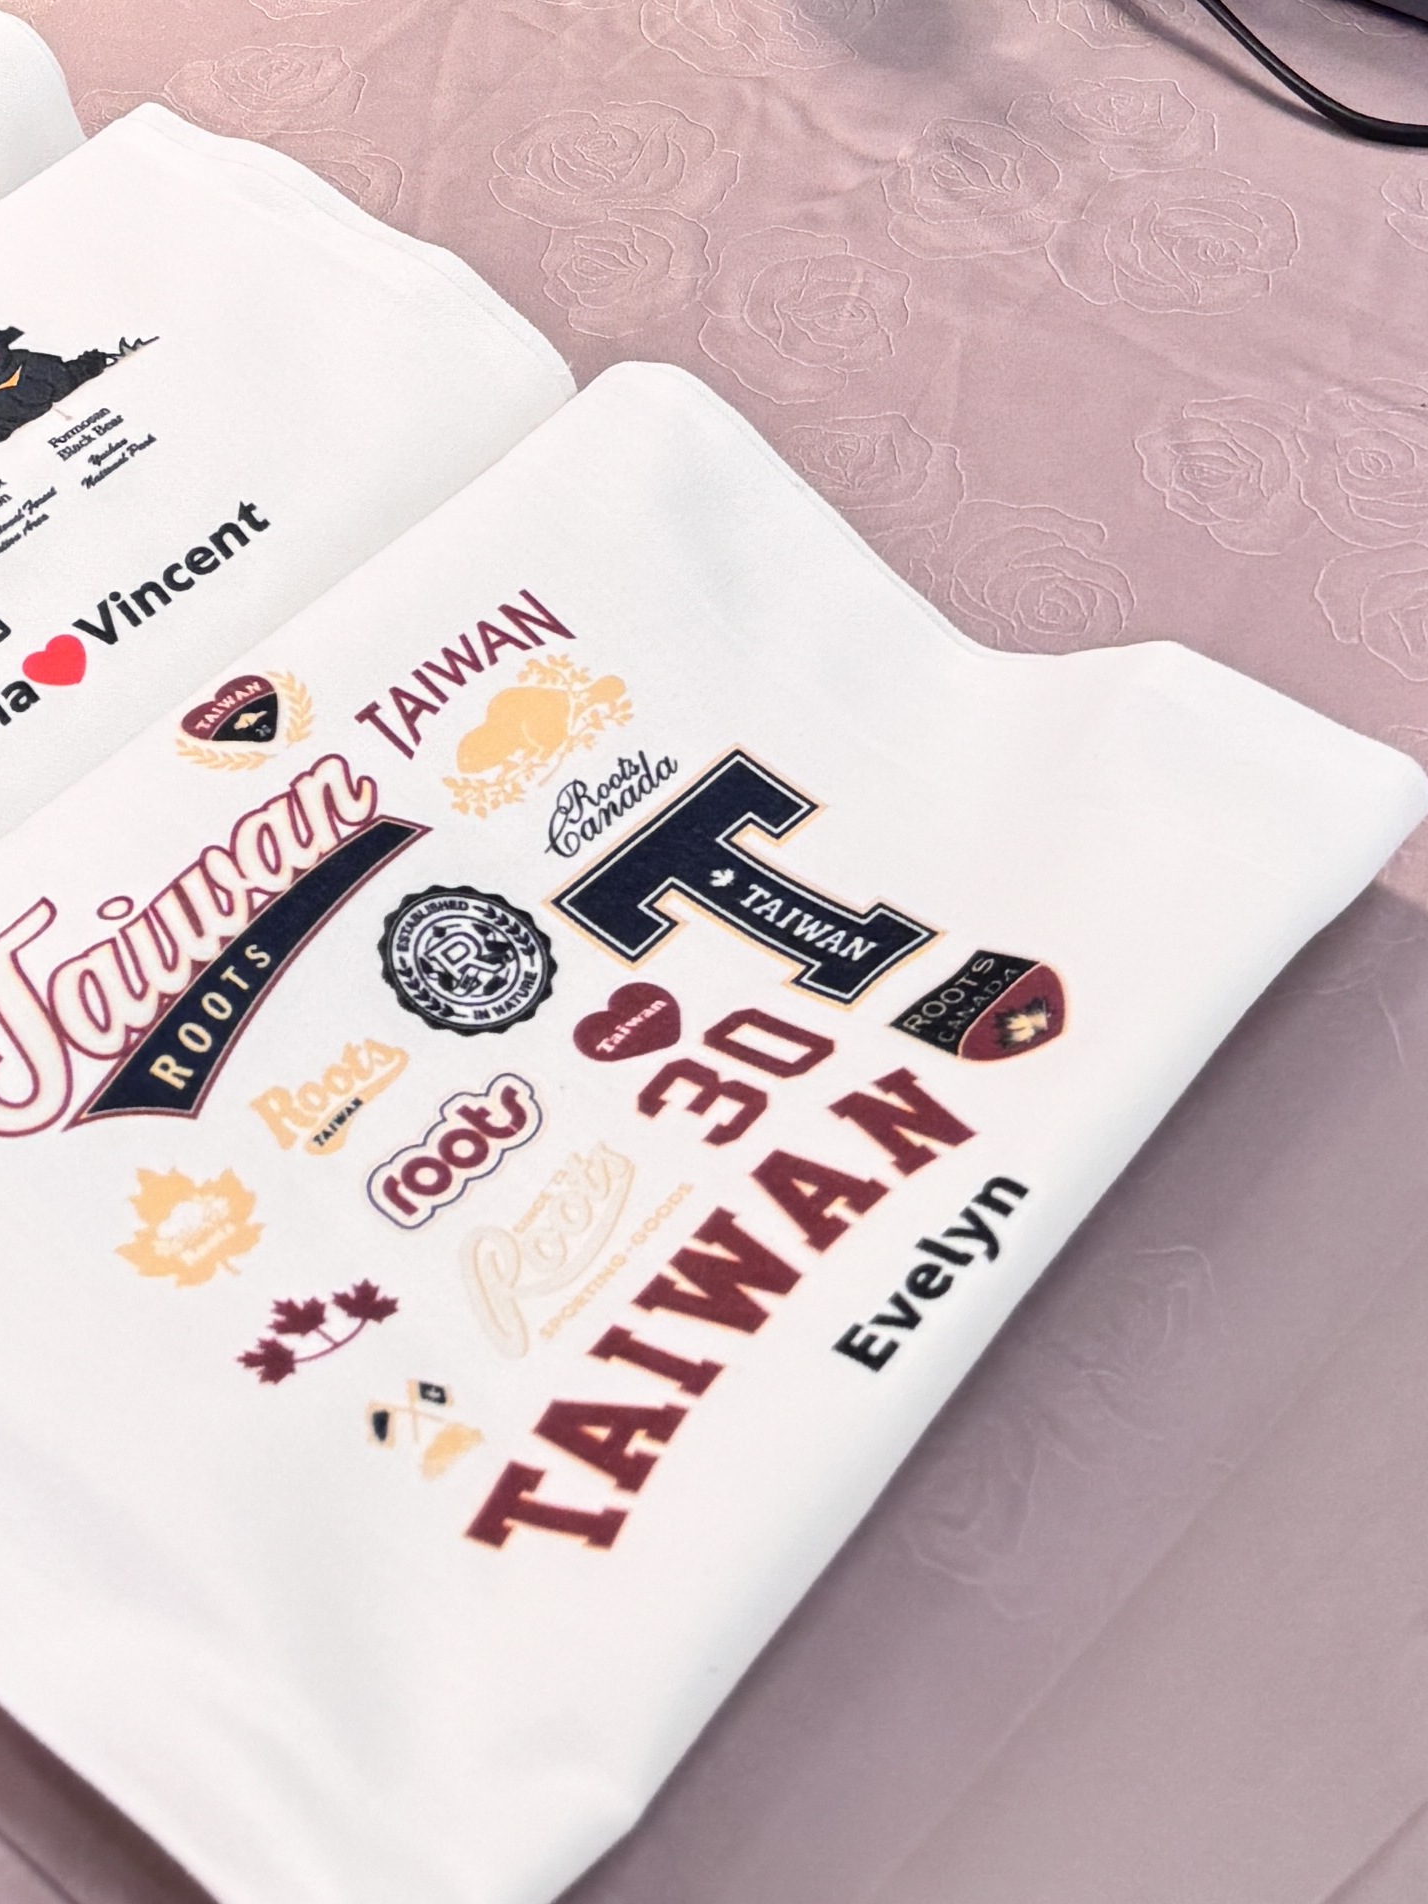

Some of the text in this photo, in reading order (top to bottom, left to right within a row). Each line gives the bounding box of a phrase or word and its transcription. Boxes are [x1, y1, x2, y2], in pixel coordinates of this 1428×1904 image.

[72, 500, 271, 646] Vincent
[195, 681, 262, 730] TAIWAN
[355, 589, 576, 760] TAIWAN
[544, 749, 678, 859] Canada
[555, 755, 642, 824] Roots
[396, 900, 469, 952] ESTABLISHED
[738, 883, 878, 962] TAIWAN
[148, 943, 272, 1091] ROOTS
[474, 971, 537, 1020] IN NATURE
[595, 999, 668, 1056] Taiwan
[903, 957, 995, 1033] ROOTS
[938, 968, 1019, 1042] CANADA
[248, 1037, 404, 1150] Roots
[313, 1097, 363, 1148] TAIWAN
[637, 1008, 835, 1146] 30
[382, 1085, 528, 1217] roots
[463, 1067, 978, 1551] TAIWAN
[832, 1174, 1030, 1373] Evelyn
